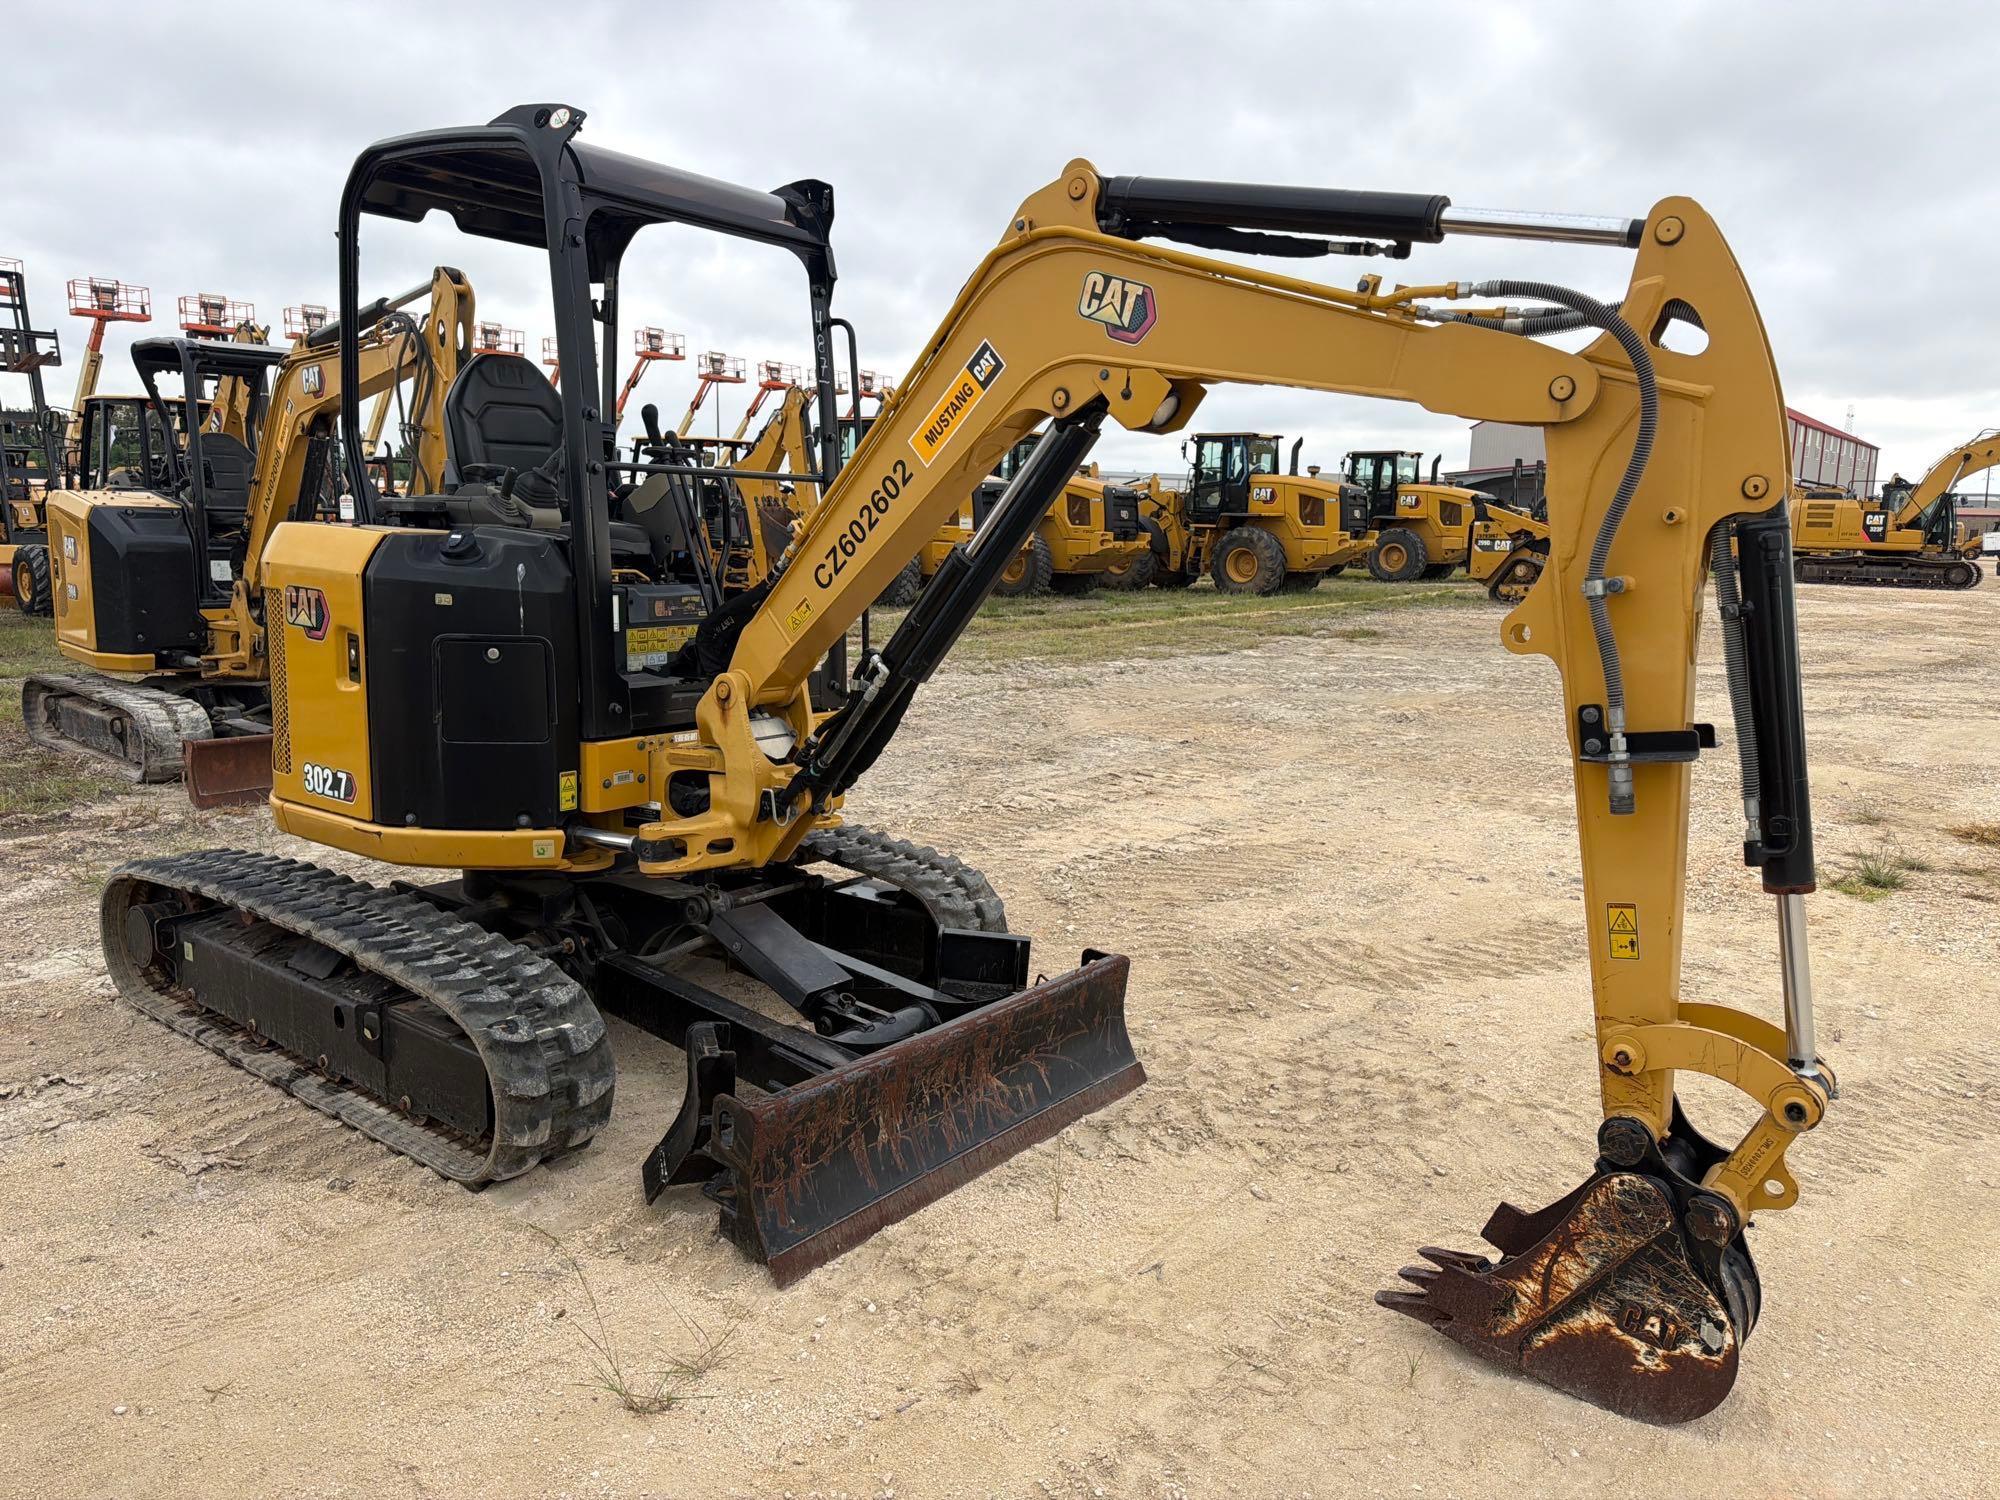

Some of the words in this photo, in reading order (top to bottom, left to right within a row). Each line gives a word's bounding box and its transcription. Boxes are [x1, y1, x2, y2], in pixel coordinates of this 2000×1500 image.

[1080, 272, 1144, 328] CAT
[302, 365, 320, 394] CAT
[924, 382, 974, 447] MUSTANG
[973, 350, 997, 382] CAT
[262, 450, 282, 514] AN402090
[1253, 488, 1272, 501] CAT
[1400, 495, 1417, 506] CAT
[814, 459, 914, 589] CZ602602
[1866, 515, 1885, 525] CAT
[1494, 540, 1511, 551] CAT
[286, 587, 319, 627] CAT
[304, 763, 347, 799] 302.7
[1619, 1301, 1681, 1350] CAT
